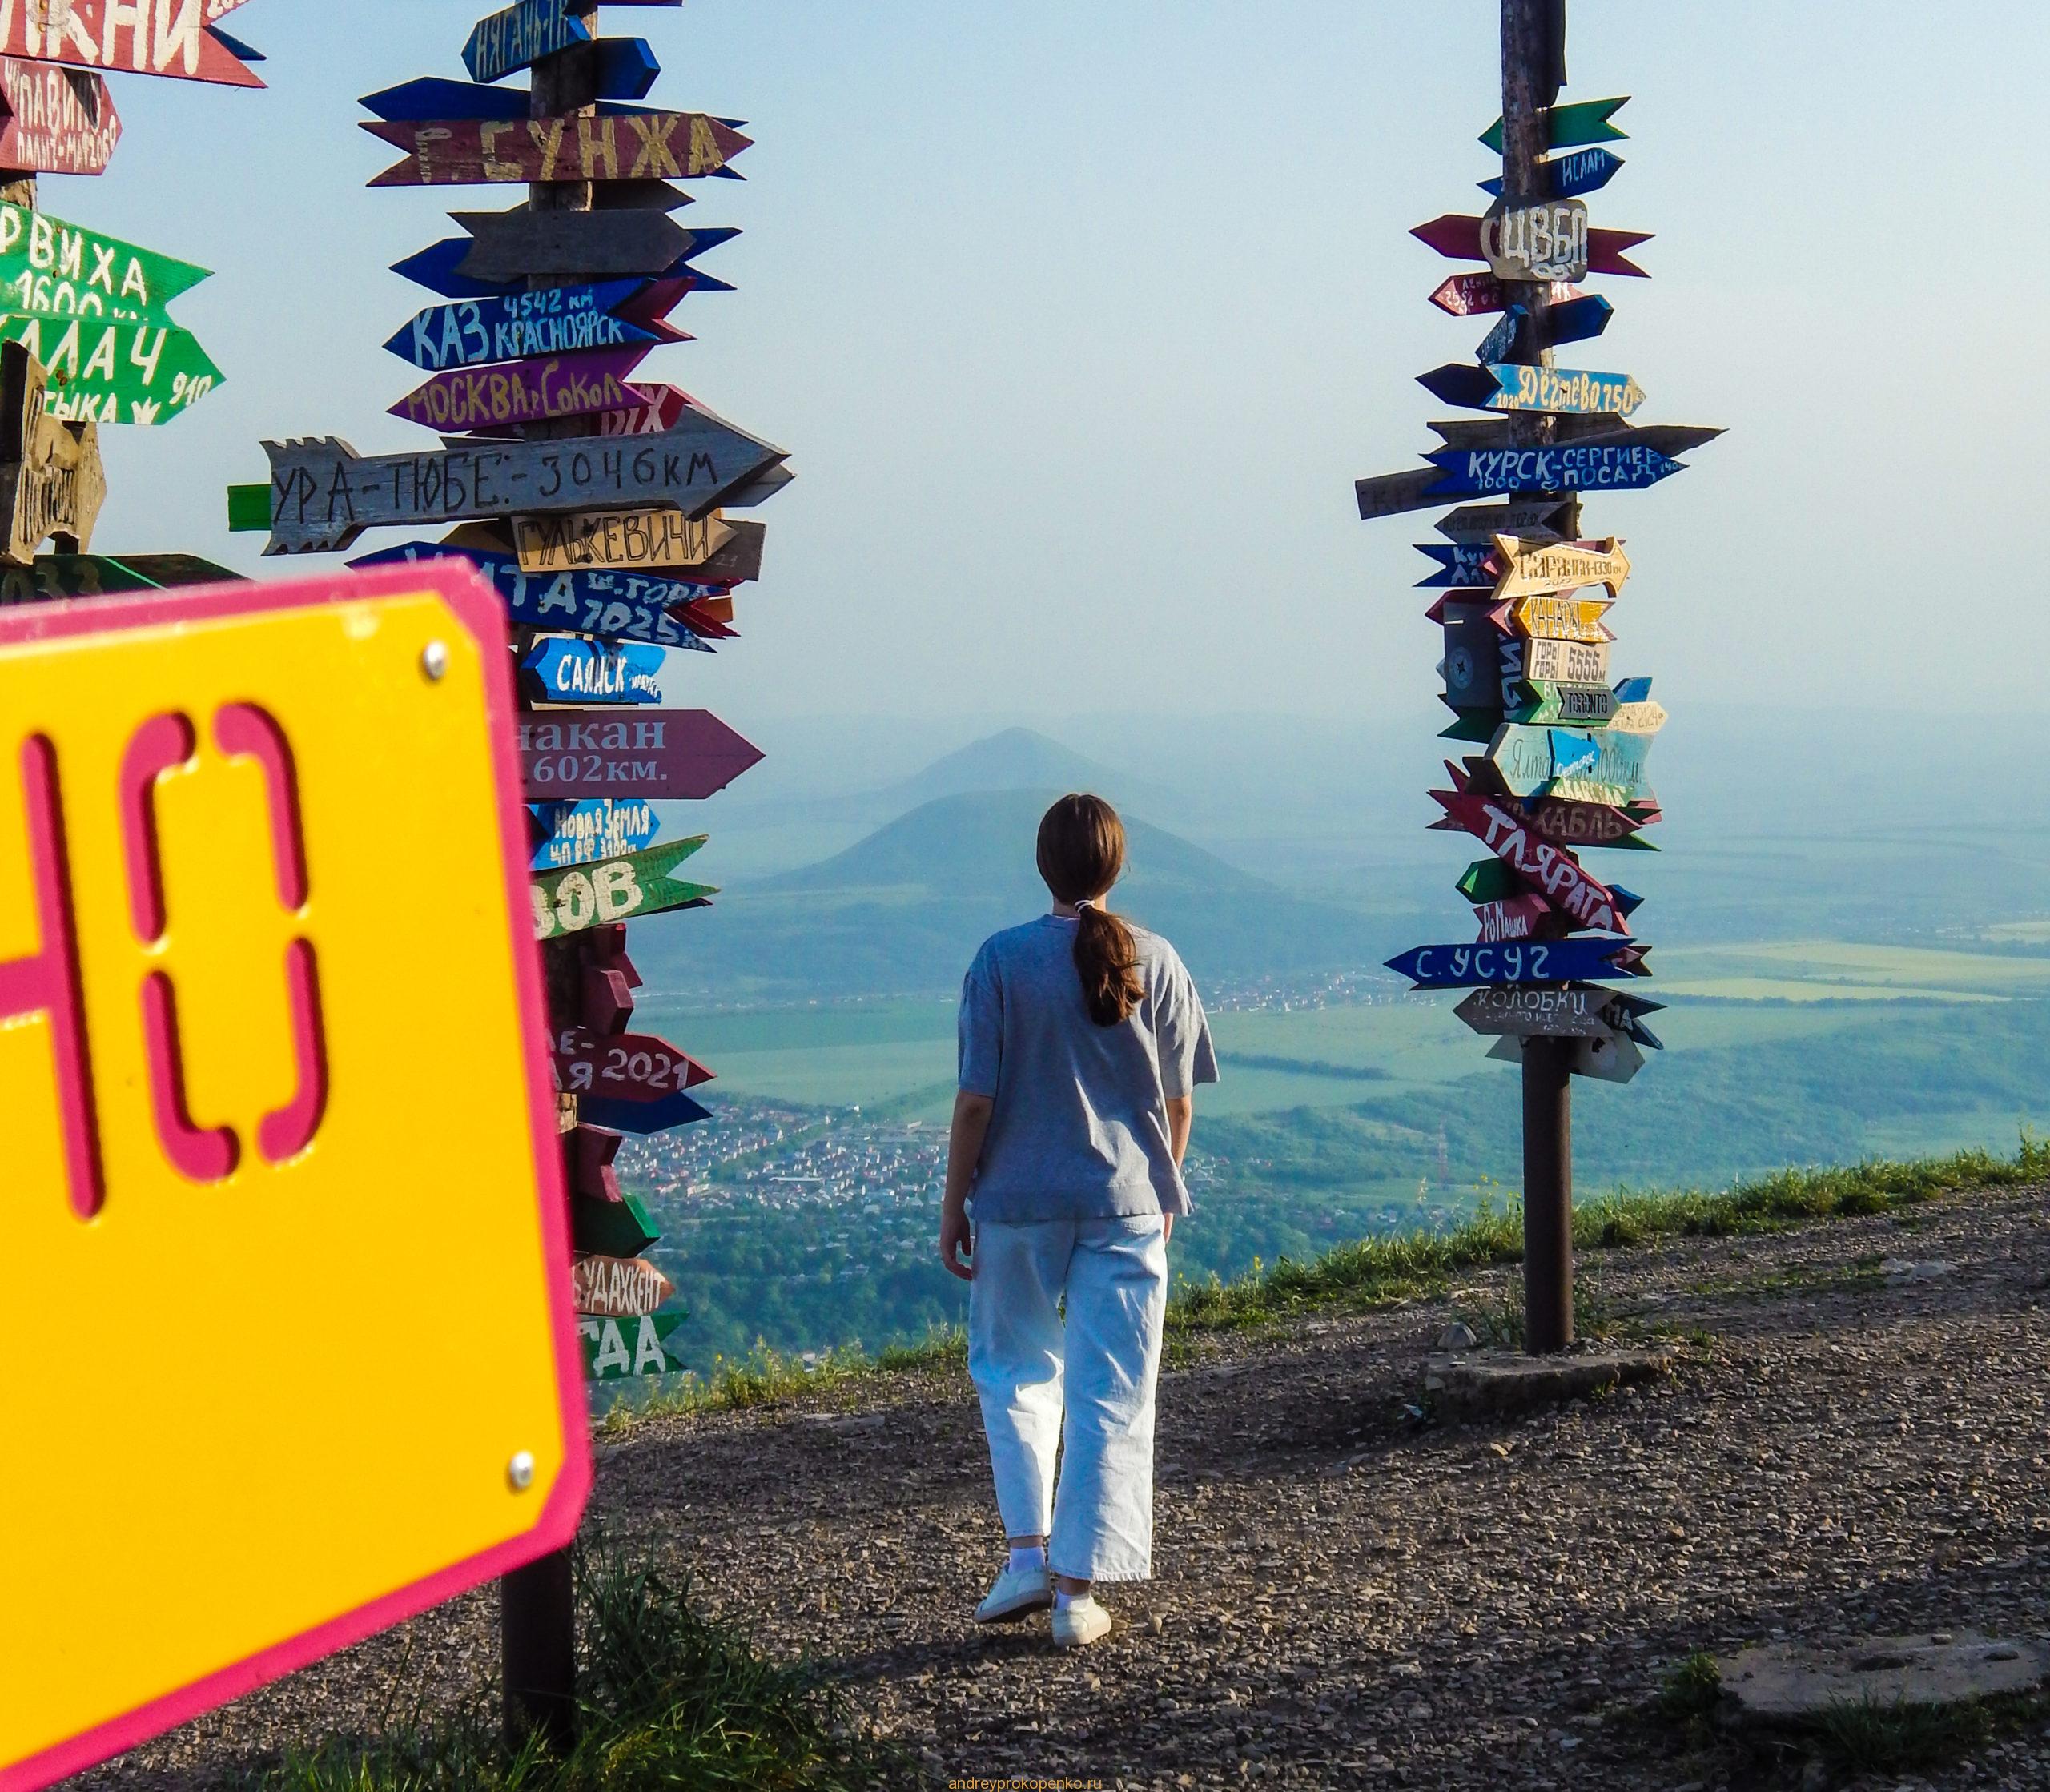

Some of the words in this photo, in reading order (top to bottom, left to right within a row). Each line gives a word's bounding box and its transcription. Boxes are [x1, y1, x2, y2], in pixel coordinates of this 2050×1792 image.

[480, 113, 725, 182] СУНЖА
[504, 290, 561, 319] 4542
[412, 300, 490, 368] КАЗ
[496, 311, 625, 360] КРАСНОЯРСК
[1563, 464, 1657, 486] ПОСАД
[517, 515, 713, 566] ГУЛЬКЕВИЧИ
[1567, 692, 1608, 714] TORONTO
[601, 1048, 689, 1091] 2021
